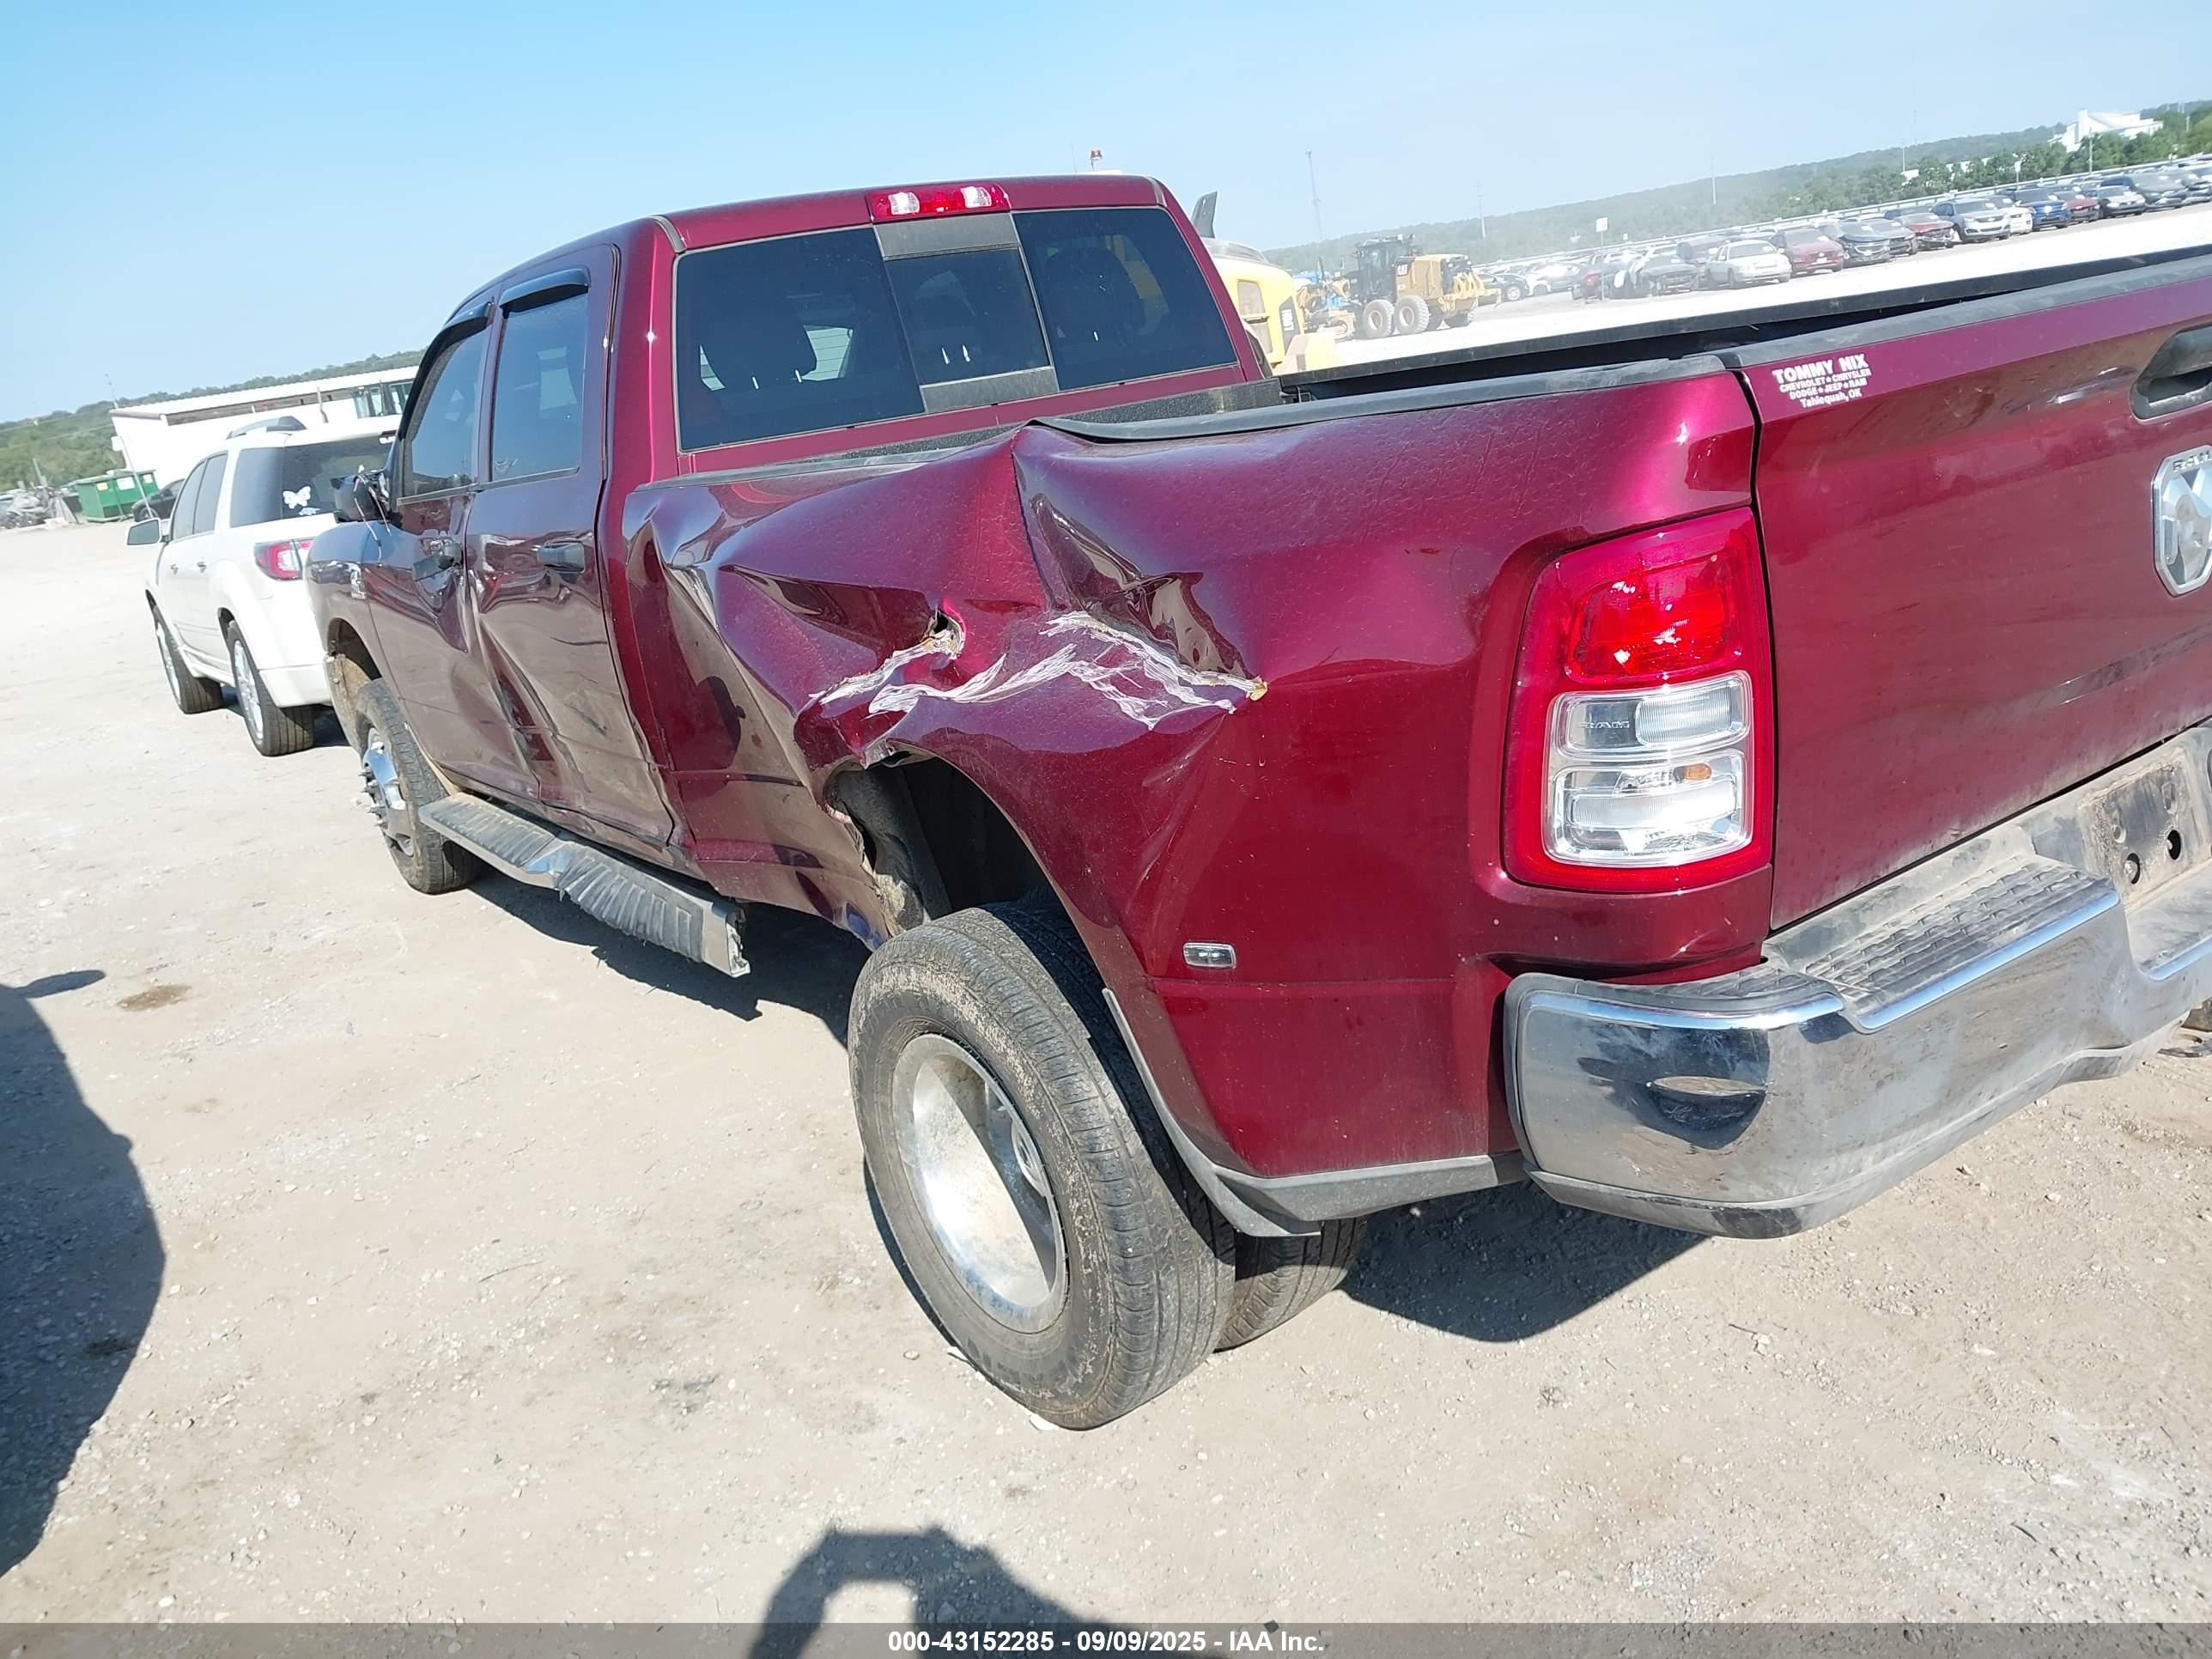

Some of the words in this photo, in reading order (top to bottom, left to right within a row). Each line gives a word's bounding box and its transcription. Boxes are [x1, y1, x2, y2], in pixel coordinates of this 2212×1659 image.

[1772, 360, 1834, 384] TOMMY
[1838, 354, 1869, 371] NIX
[1779, 376, 1826, 392] CHEVROLET
[1832, 368, 1872, 383] CHRYSLER
[1789, 386, 1818, 400] DODGE
[1825, 382, 1843, 393] JEEP
[1849, 378, 1868, 388] RAM
[1848, 388, 1862, 398] OK
[1578, 720, 1630, 729] RAM
